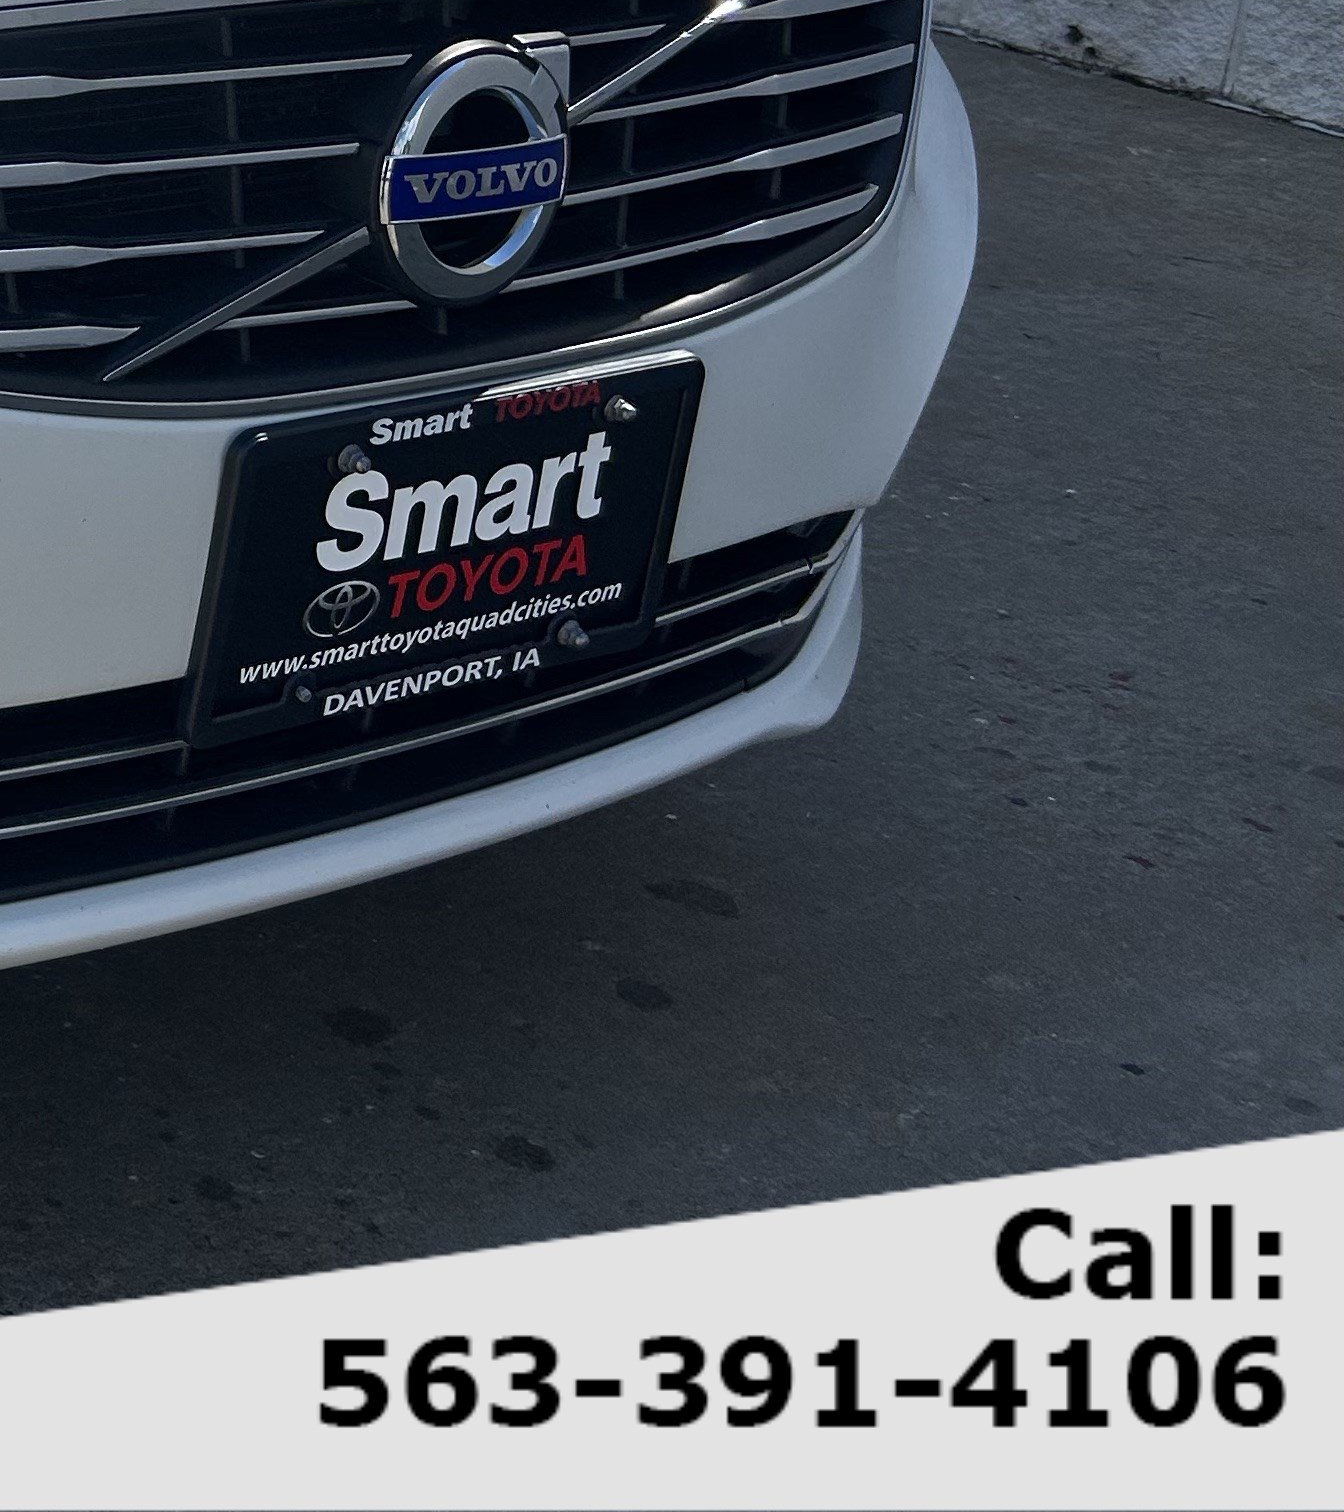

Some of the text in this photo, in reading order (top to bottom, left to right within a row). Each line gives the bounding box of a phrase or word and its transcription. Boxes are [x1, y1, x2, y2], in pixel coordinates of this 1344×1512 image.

[404, 158, 558, 204] VOLVO
[369, 380, 600, 445] Smart TOYOTA
[316, 432, 611, 572] Smart
[388, 535, 587, 618] TOYOTA
[239, 581, 622, 684] www.smarttoyotaquadcities.com
[323, 647, 541, 717] DAVENPORT, IA
